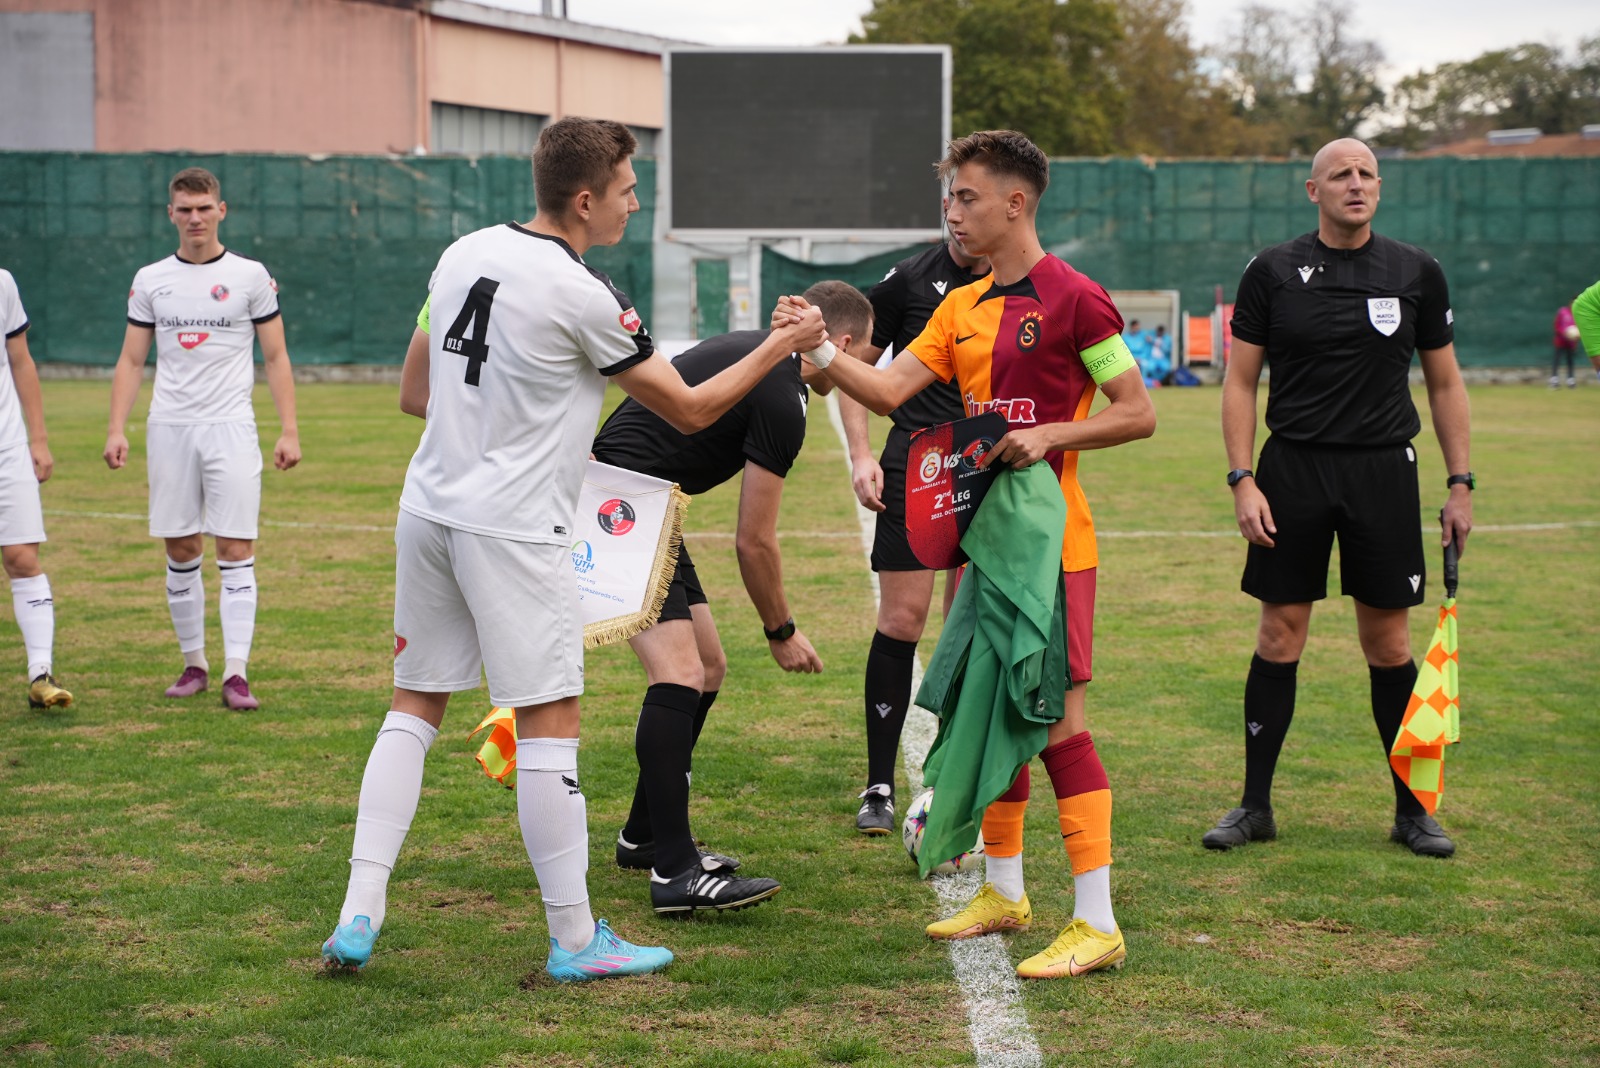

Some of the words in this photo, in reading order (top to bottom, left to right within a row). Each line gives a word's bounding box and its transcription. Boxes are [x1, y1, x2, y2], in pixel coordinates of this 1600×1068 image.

[180, 333, 199, 343] MOL
[442, 276, 500, 387] 4
[446, 337, 462, 351] U19
[943, 453, 962, 469] VS
[912, 480, 940, 492] GALATASARAY
[934, 489, 952, 509] 2nd
[952, 489, 971, 504] LEG
[944, 504, 967, 516] OCTOBER
[573, 557, 595, 570] UTH
